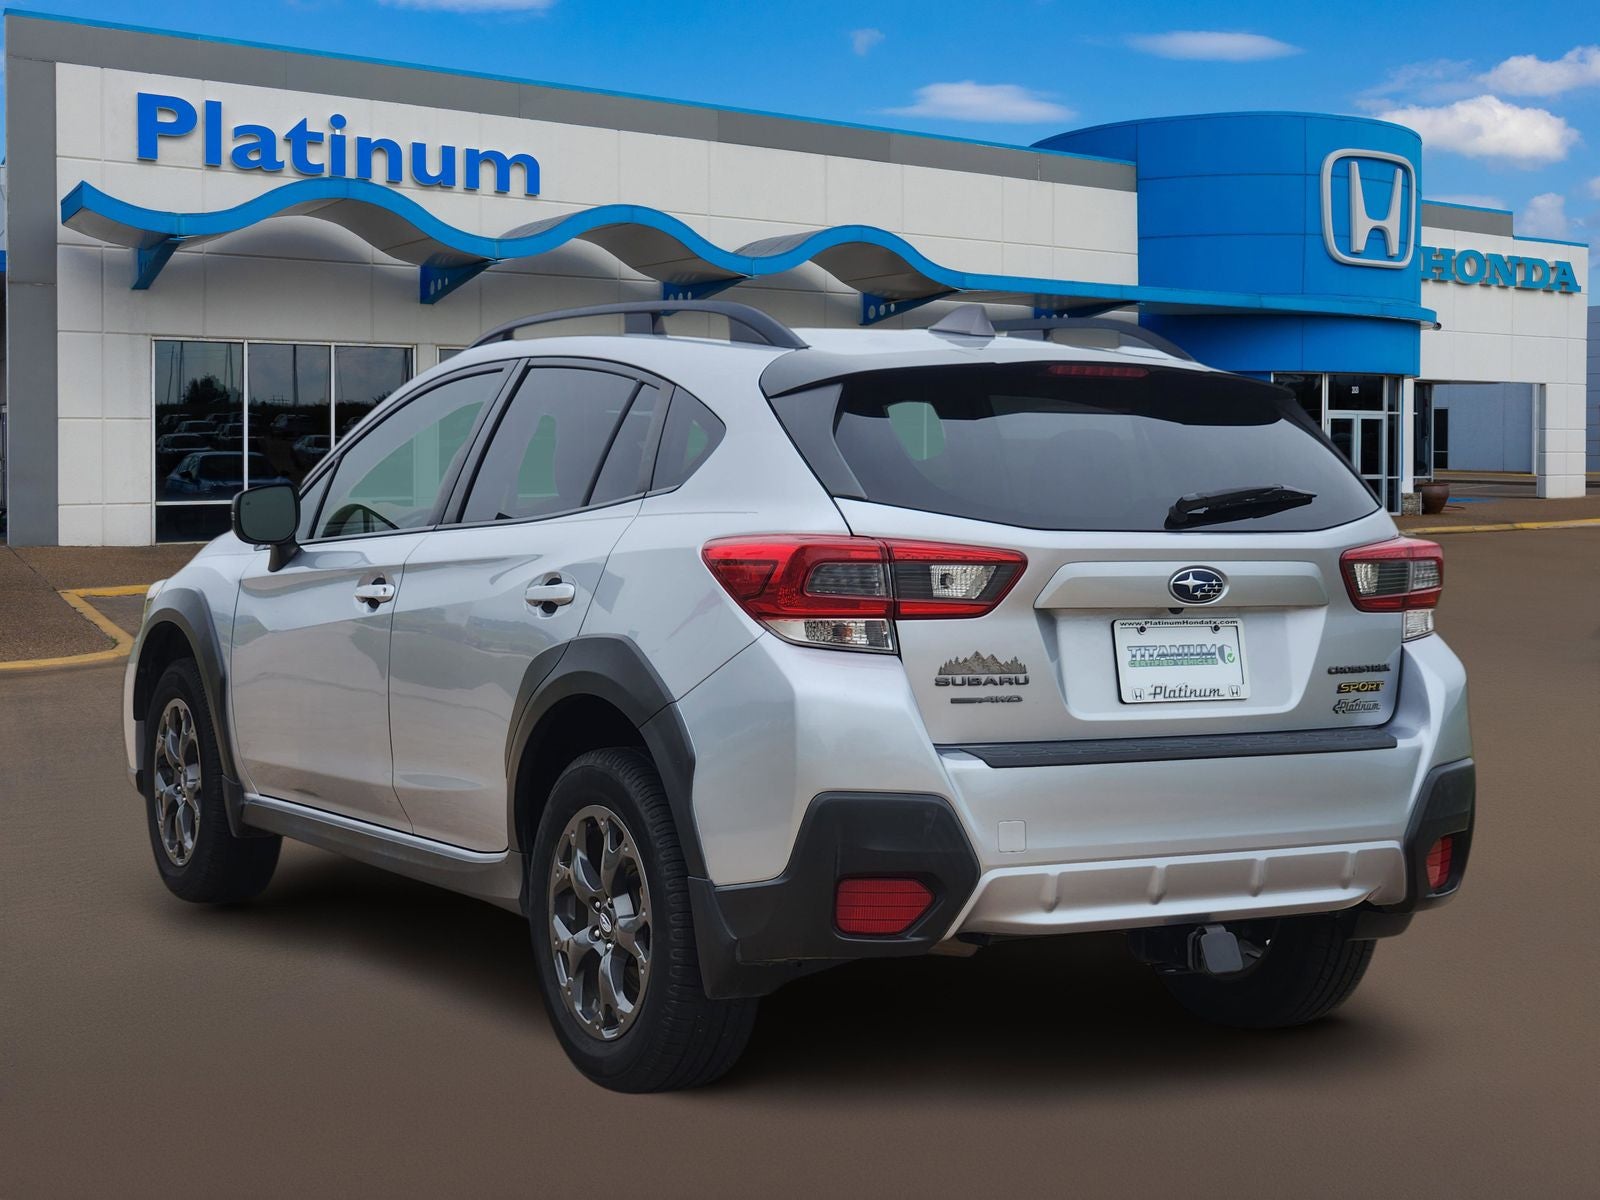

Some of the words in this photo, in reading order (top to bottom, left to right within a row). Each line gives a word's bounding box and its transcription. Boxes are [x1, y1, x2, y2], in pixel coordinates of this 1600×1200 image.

[137, 92, 540, 196] Platinum
[1421, 246, 1581, 292] HONDA
[1127, 644, 1216, 660] TITANIUM
[935, 675, 1030, 687] SUBARU
[1337, 681, 1385, 694] SPORT
[1148, 684, 1225, 699] Platinum
[1335, 699, 1382, 713] Platinum
